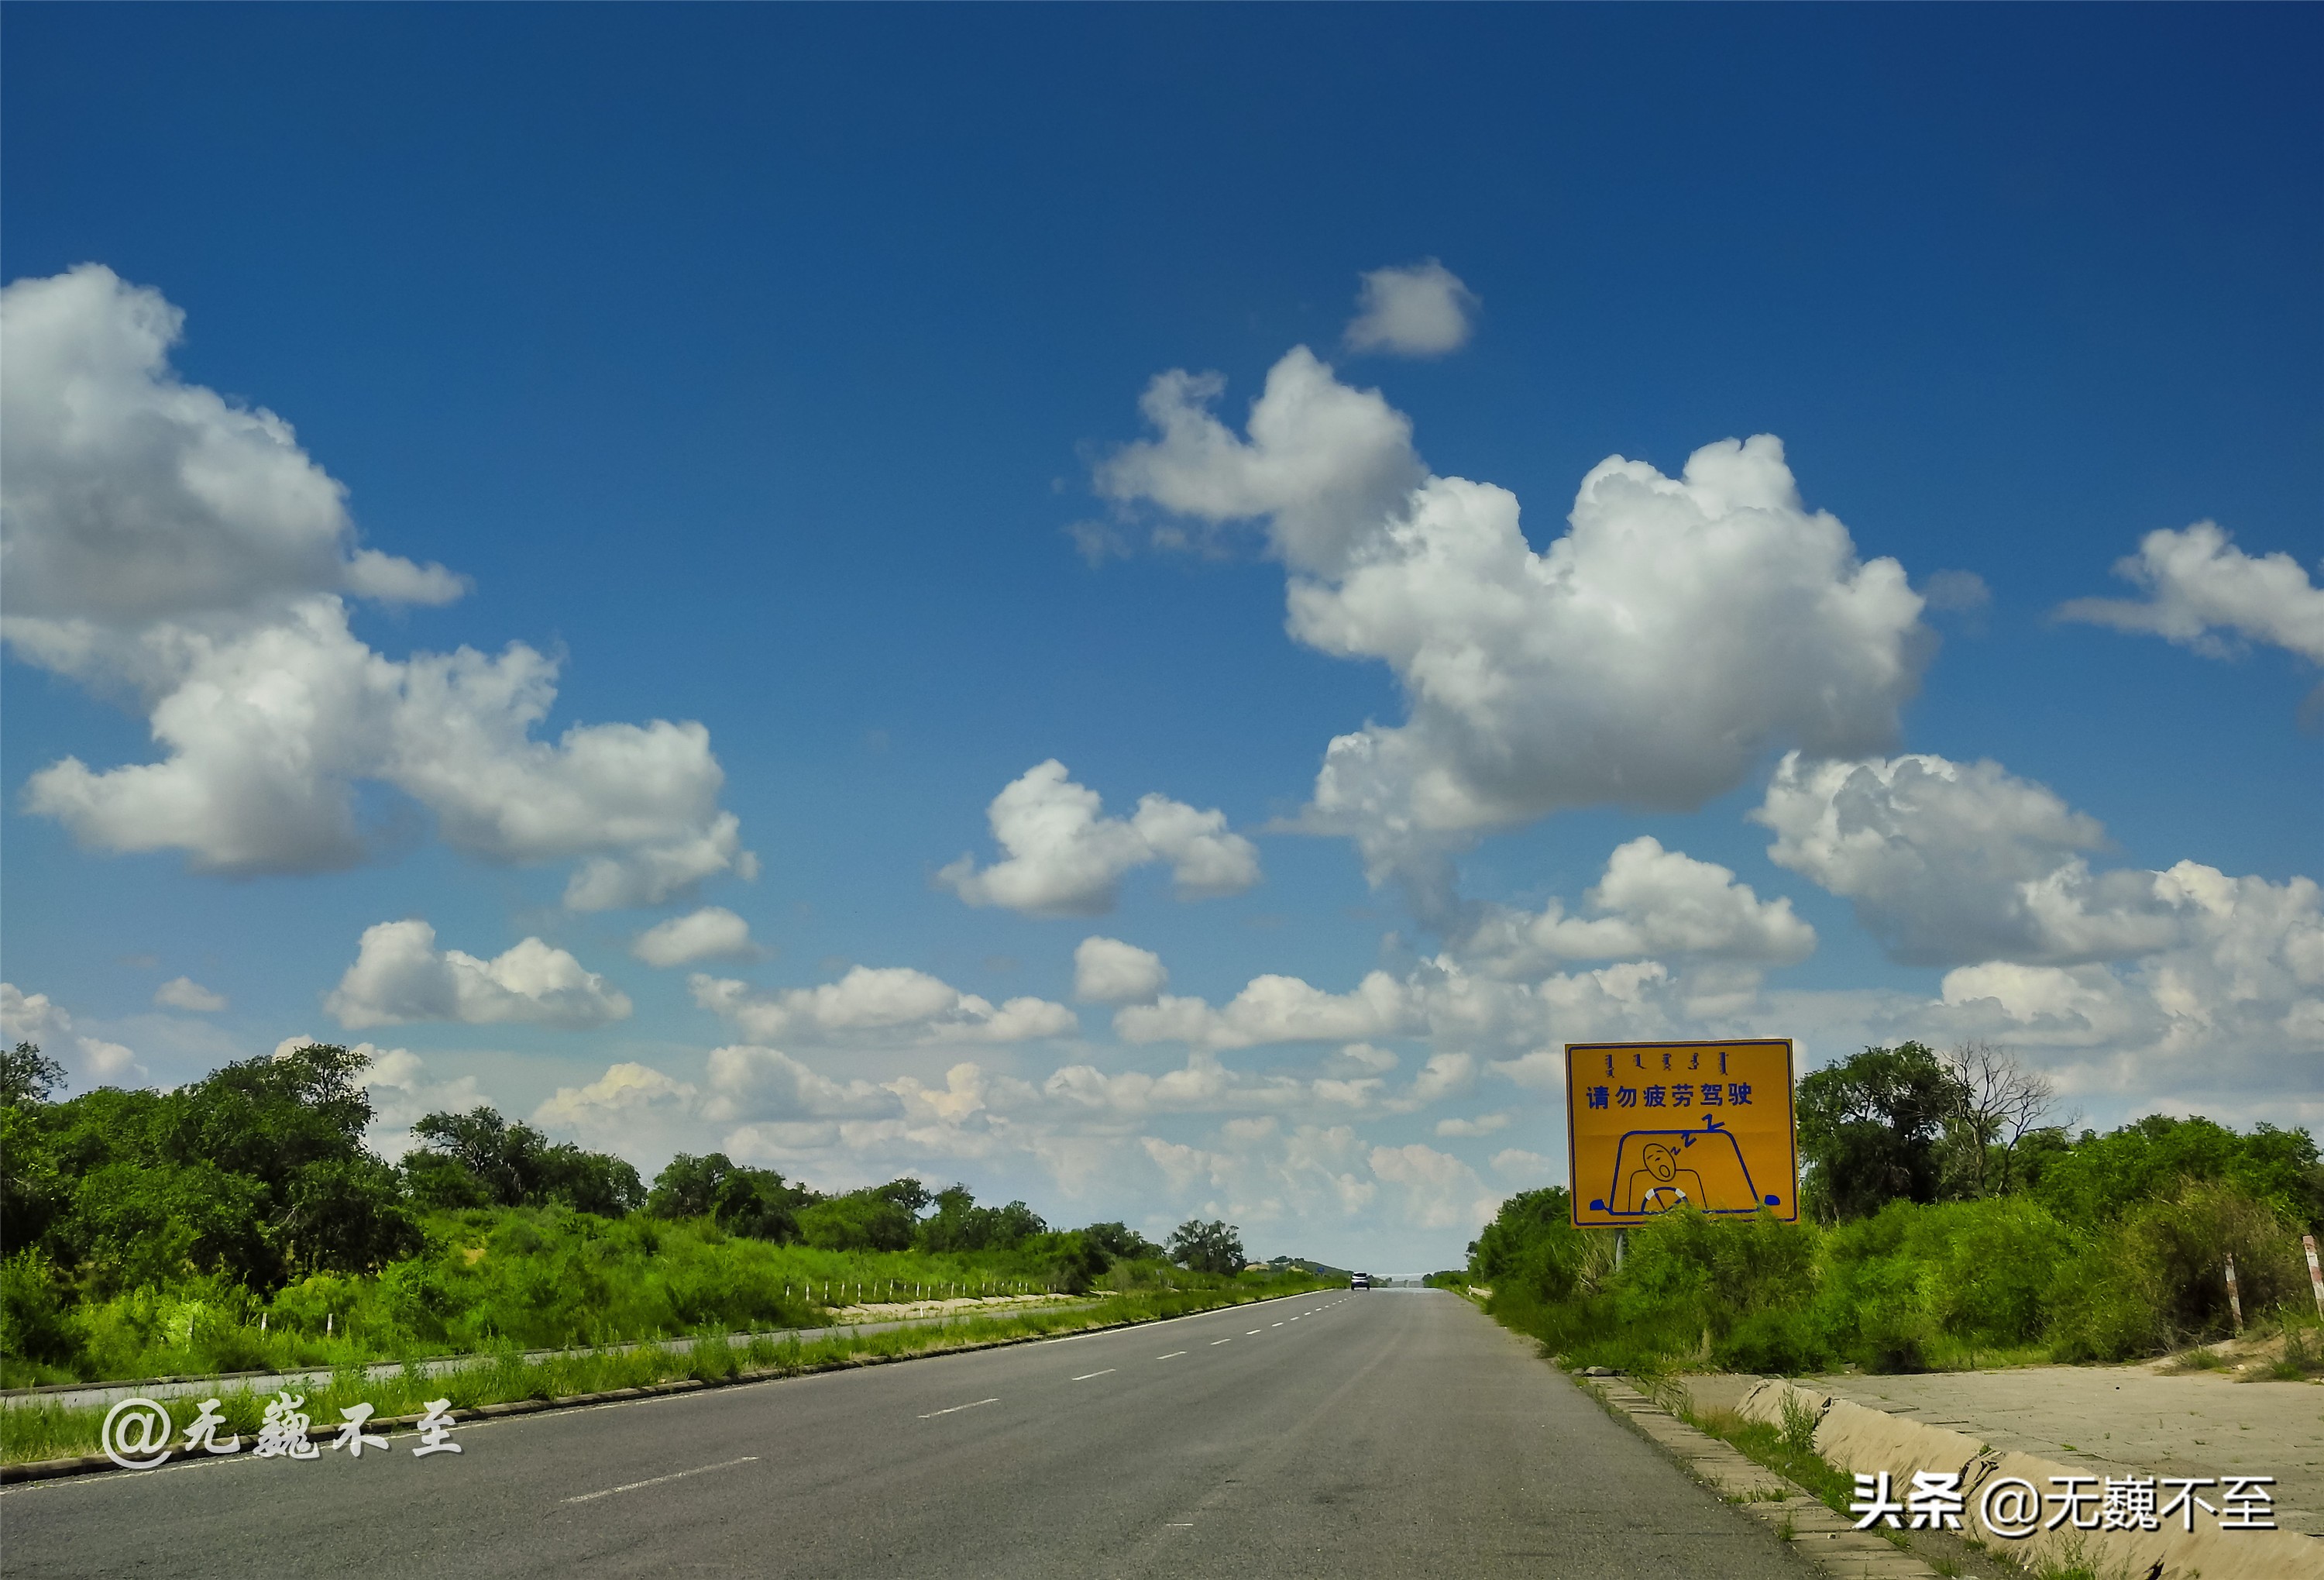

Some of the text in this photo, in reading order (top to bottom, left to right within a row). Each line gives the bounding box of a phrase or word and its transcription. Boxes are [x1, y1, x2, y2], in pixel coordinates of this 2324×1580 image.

[1587, 1082, 1752, 1110] 请勿疲劳驾驶
